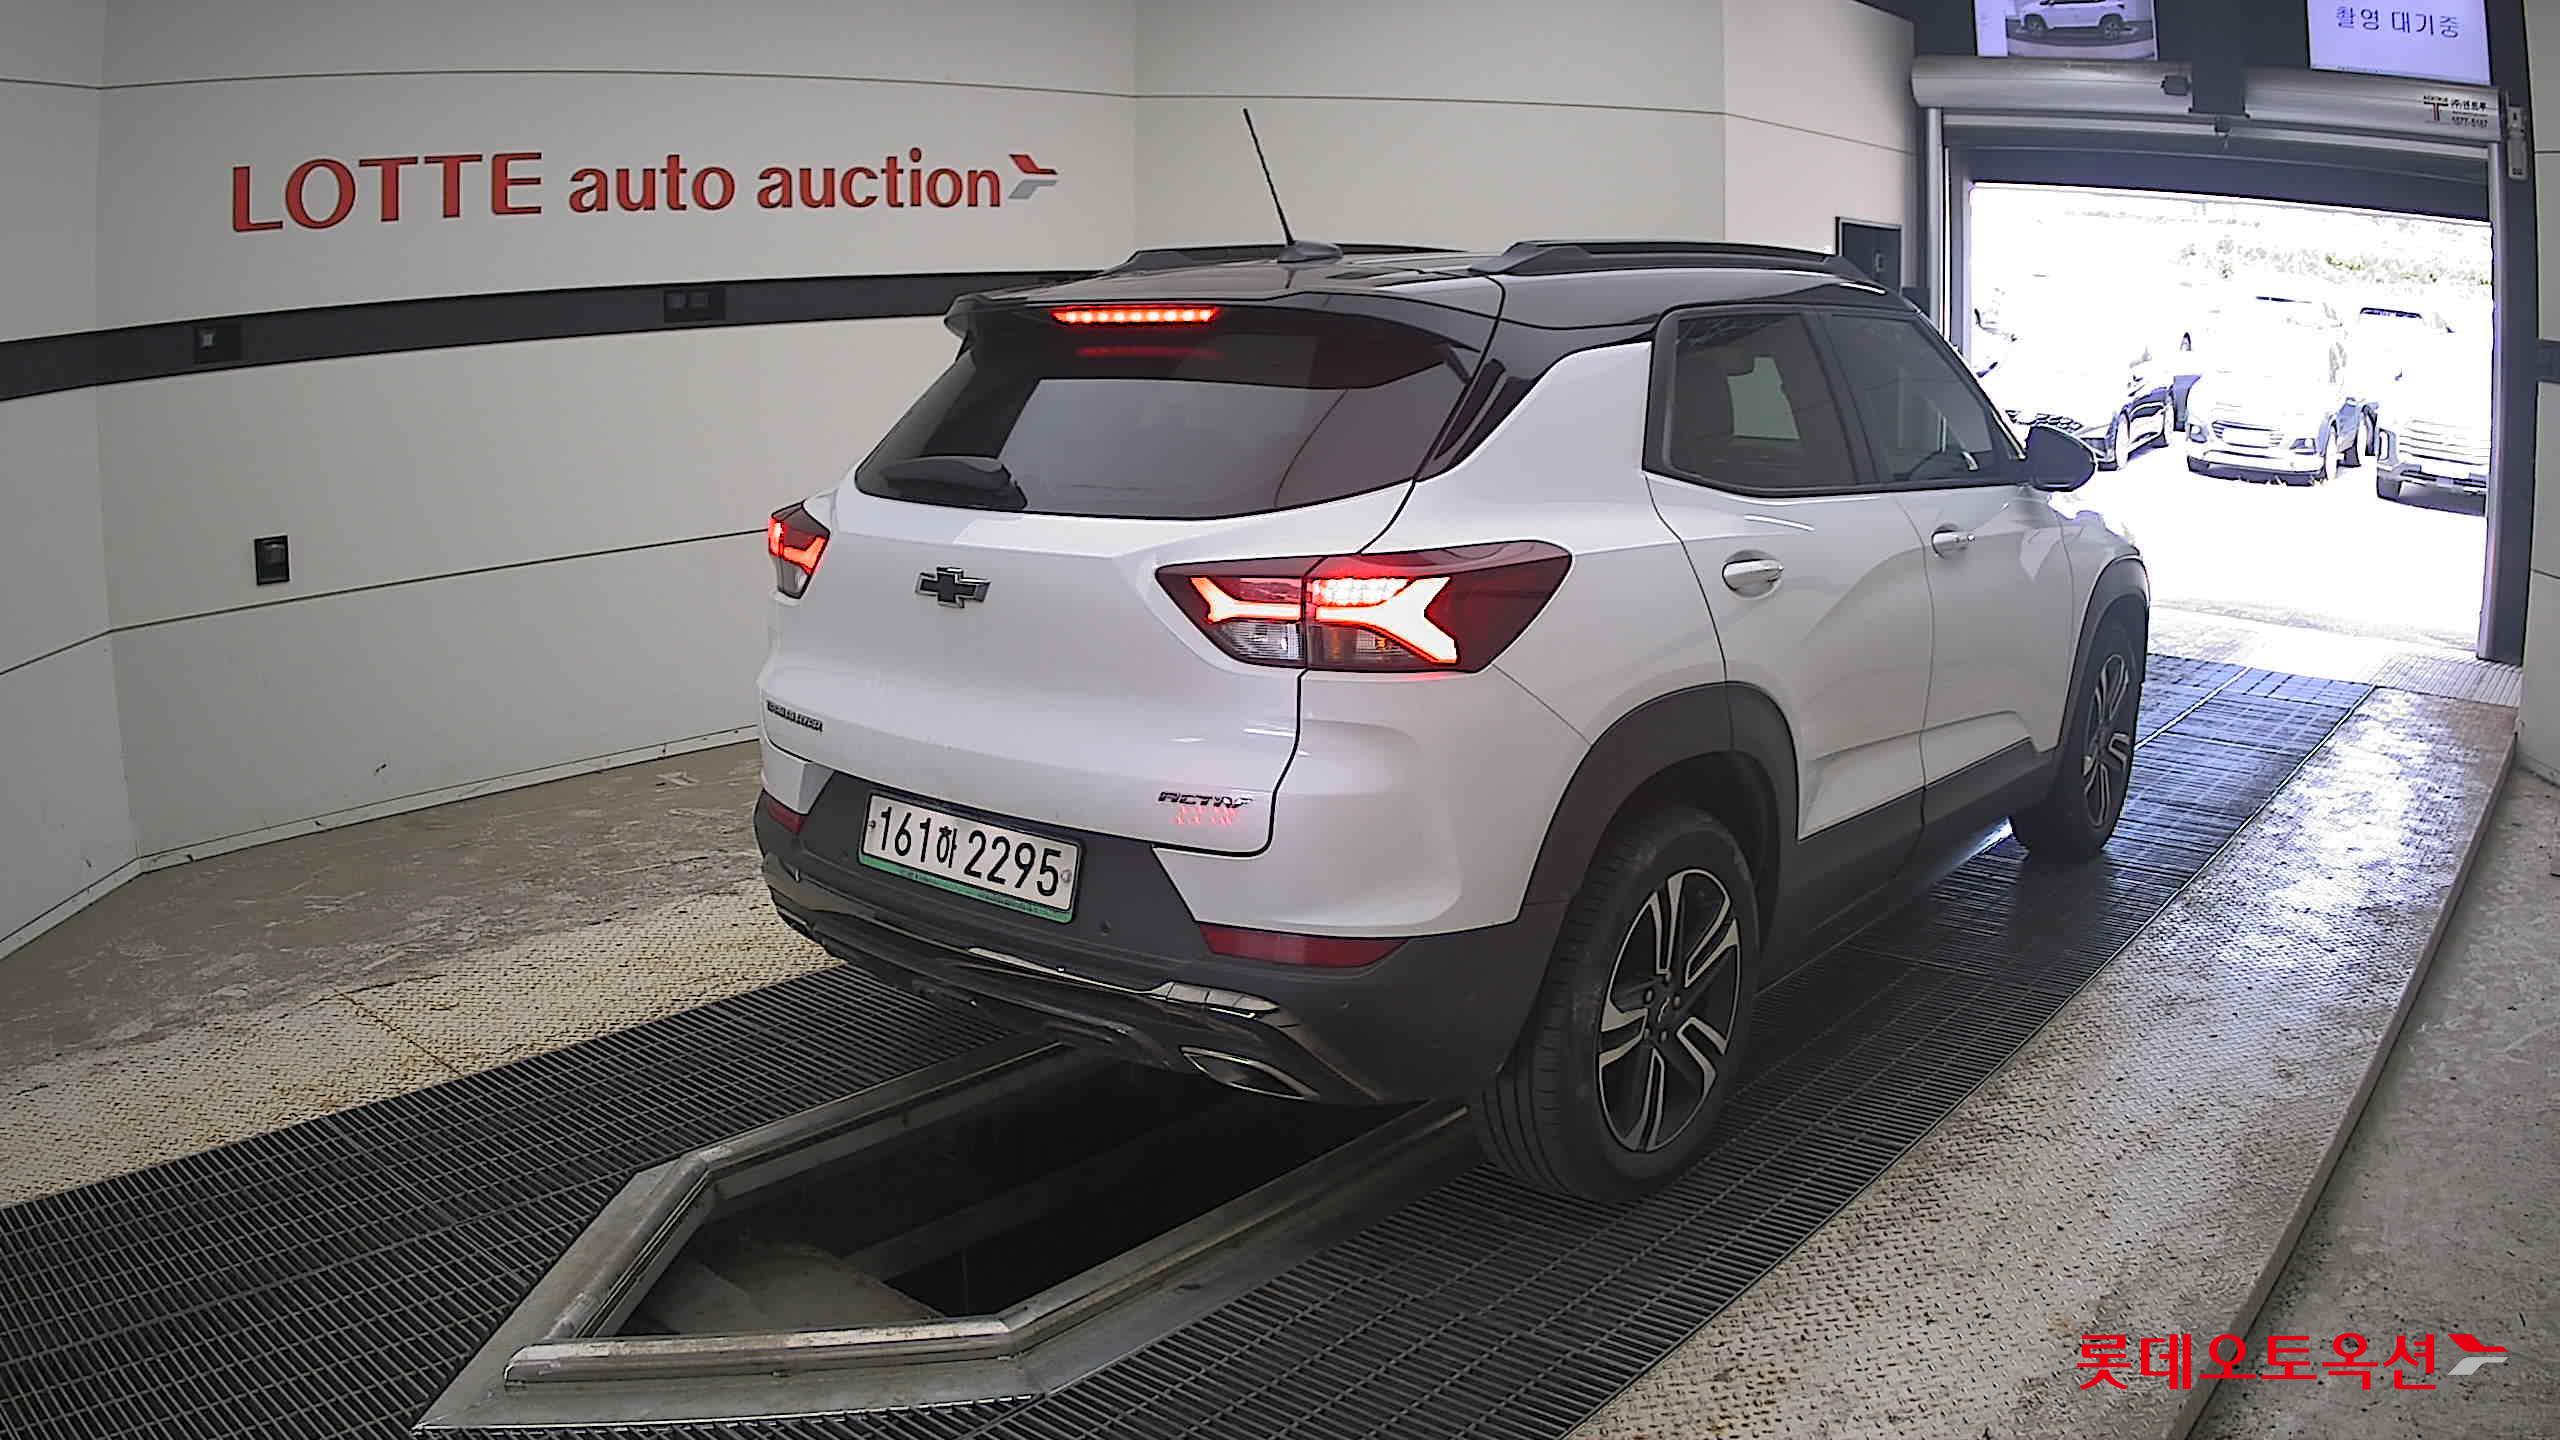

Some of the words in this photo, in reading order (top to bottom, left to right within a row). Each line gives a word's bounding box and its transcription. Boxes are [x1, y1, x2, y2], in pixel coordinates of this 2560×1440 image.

[2335, 6, 2380, 31] 촬영
[2391, 11, 2460, 39] 대기중
[232, 151, 543, 233] LOTTE
[568, 154, 736, 213] auto
[757, 147, 1002, 209] auction
[963, 829, 1060, 897] 2295
